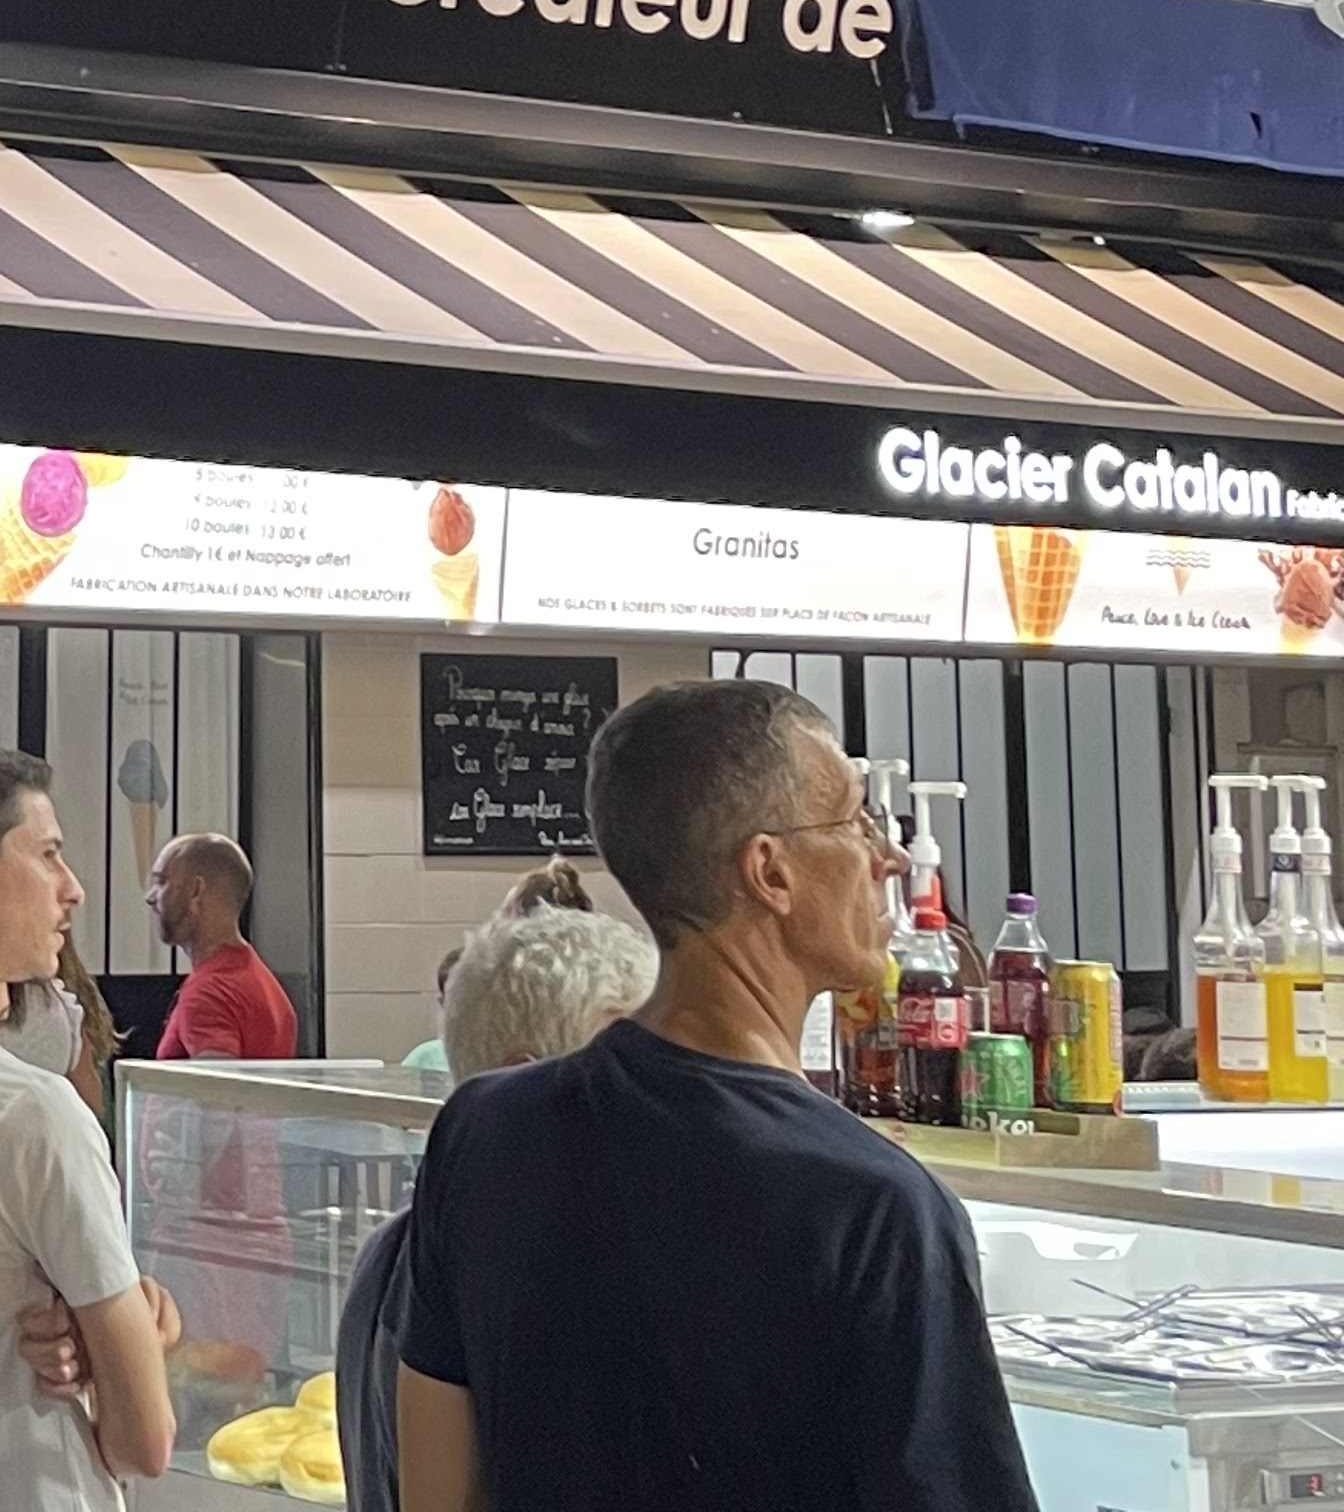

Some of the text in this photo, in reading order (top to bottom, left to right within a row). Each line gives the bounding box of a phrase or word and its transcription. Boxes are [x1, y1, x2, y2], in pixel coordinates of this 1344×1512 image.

[877, 426, 1073, 503] Glacier
[1084, 442, 1282, 518] Catalan
[693, 527, 800, 560] Granitas
[71, 576, 411, 604] FABRICATION ARTISANALE DANS NOTRE LABORATOIRE
